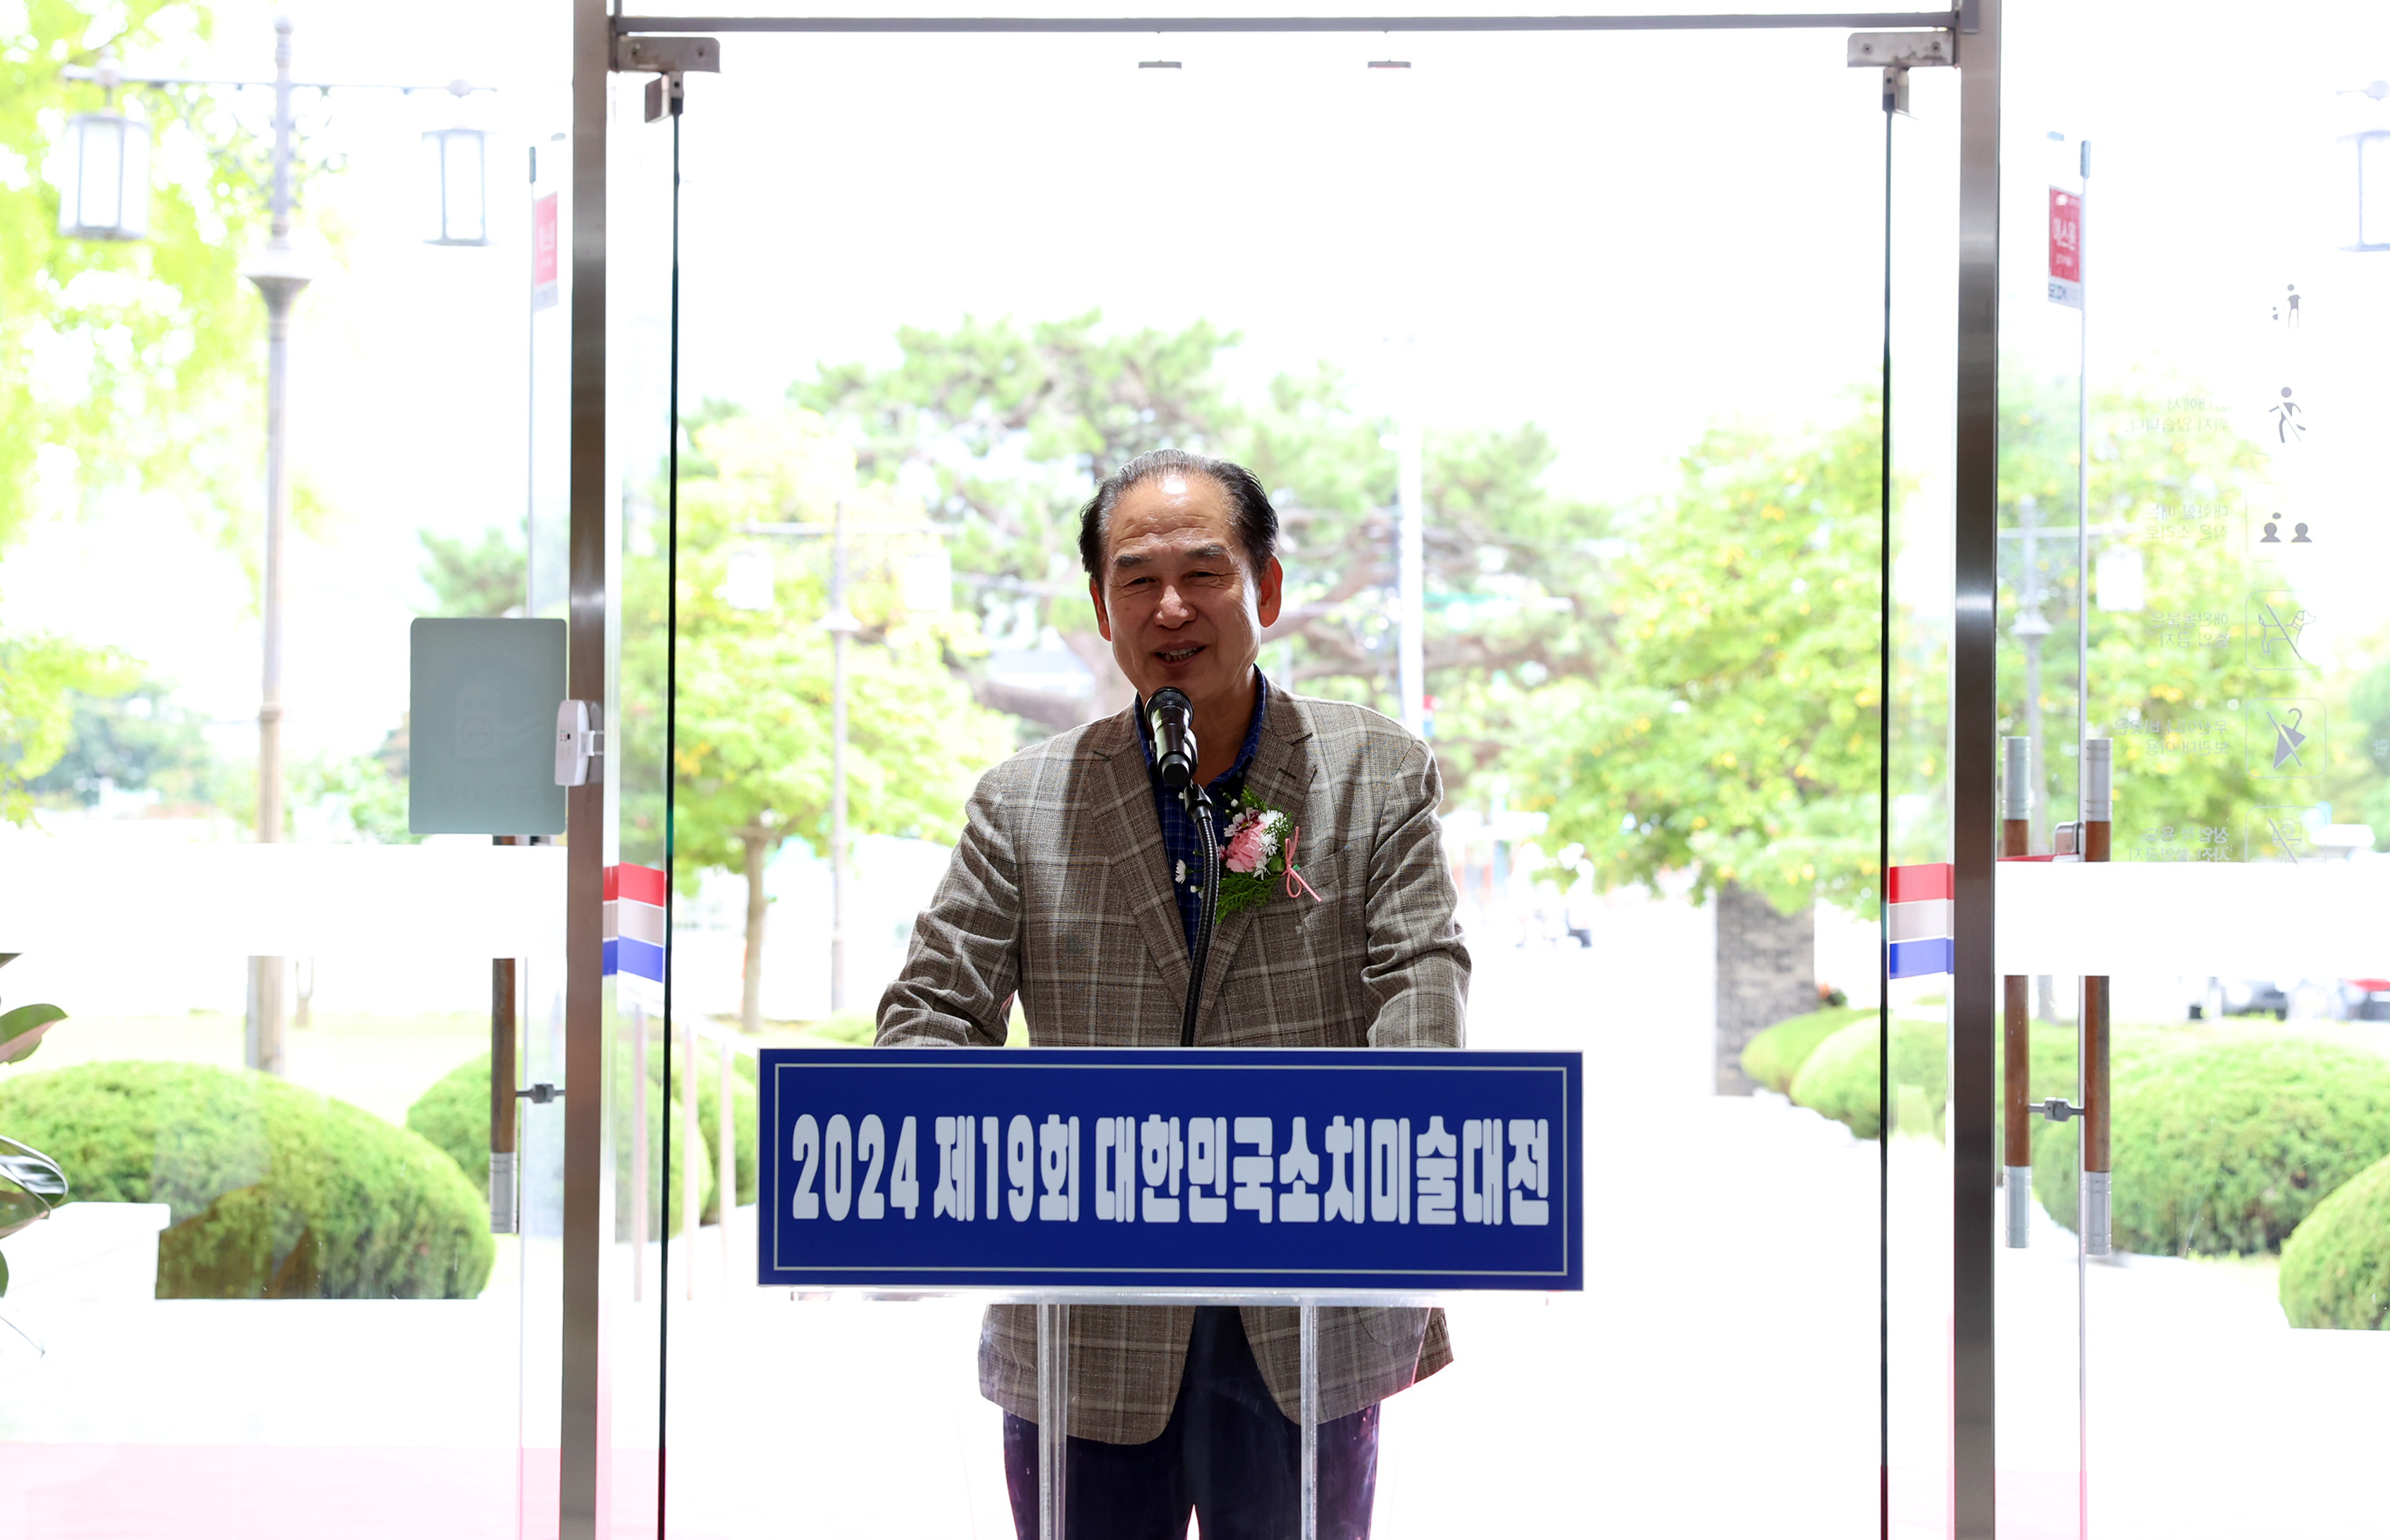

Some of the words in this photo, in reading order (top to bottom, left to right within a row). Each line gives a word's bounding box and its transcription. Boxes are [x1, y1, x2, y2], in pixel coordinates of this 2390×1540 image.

[792, 1114, 919, 1221] 2024
[934, 1114, 1079, 1222] 제19회
[1095, 1114, 1549, 1225] 대한민국소치미술대전
